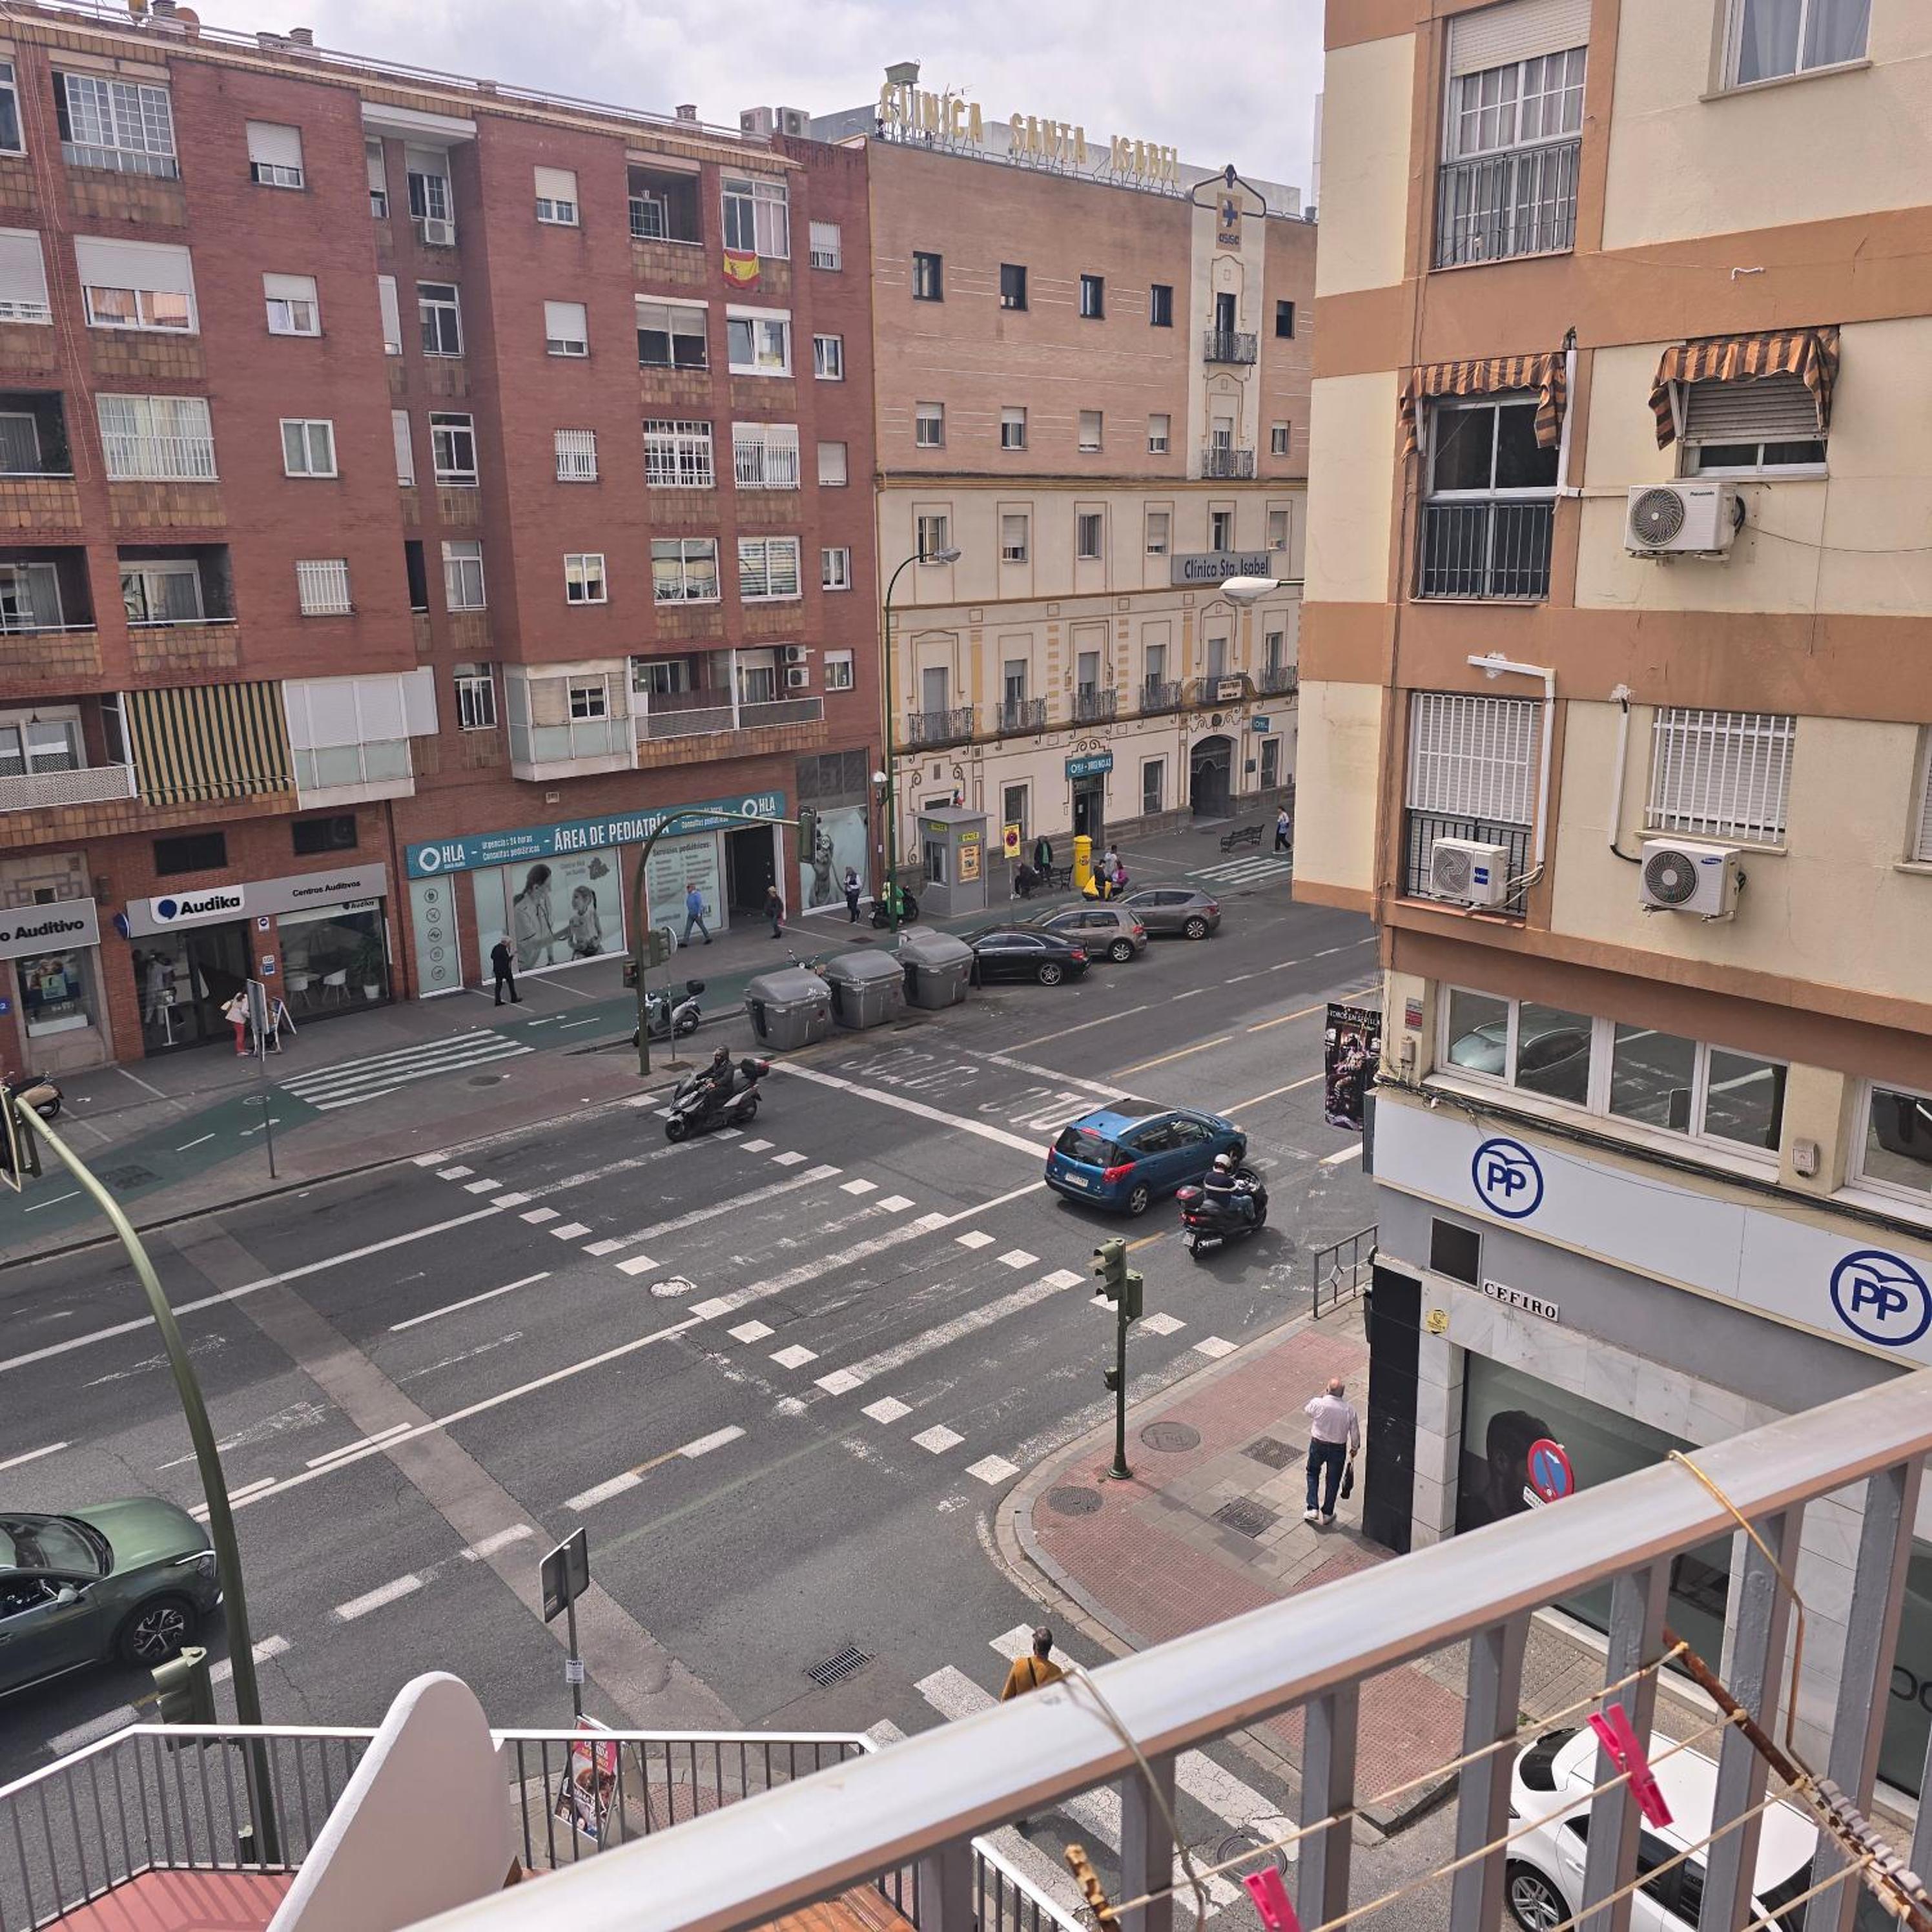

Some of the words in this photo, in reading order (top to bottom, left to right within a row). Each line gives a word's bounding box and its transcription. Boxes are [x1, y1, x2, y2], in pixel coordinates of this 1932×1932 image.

[1010, 113, 1088, 165] SANTA
[1109, 134, 1180, 183] ISABEL
[1240, 555, 1268, 575] Isabel
[758, 796, 776, 813] HLA
[555, 827, 587, 851] ÁREA
[589, 825, 606, 847] DE
[442, 844, 466, 863] HLA
[293, 887, 324, 897] Centros
[325, 881, 361, 892] Auditivos
[180, 896, 241, 915] Audika
[15, 920, 85, 940] Auditivo
[1487, 1161, 1526, 1198] PP
[1485, 1282, 1556, 1319] CEFIRO
[1851, 1277, 1908, 1321] PP
